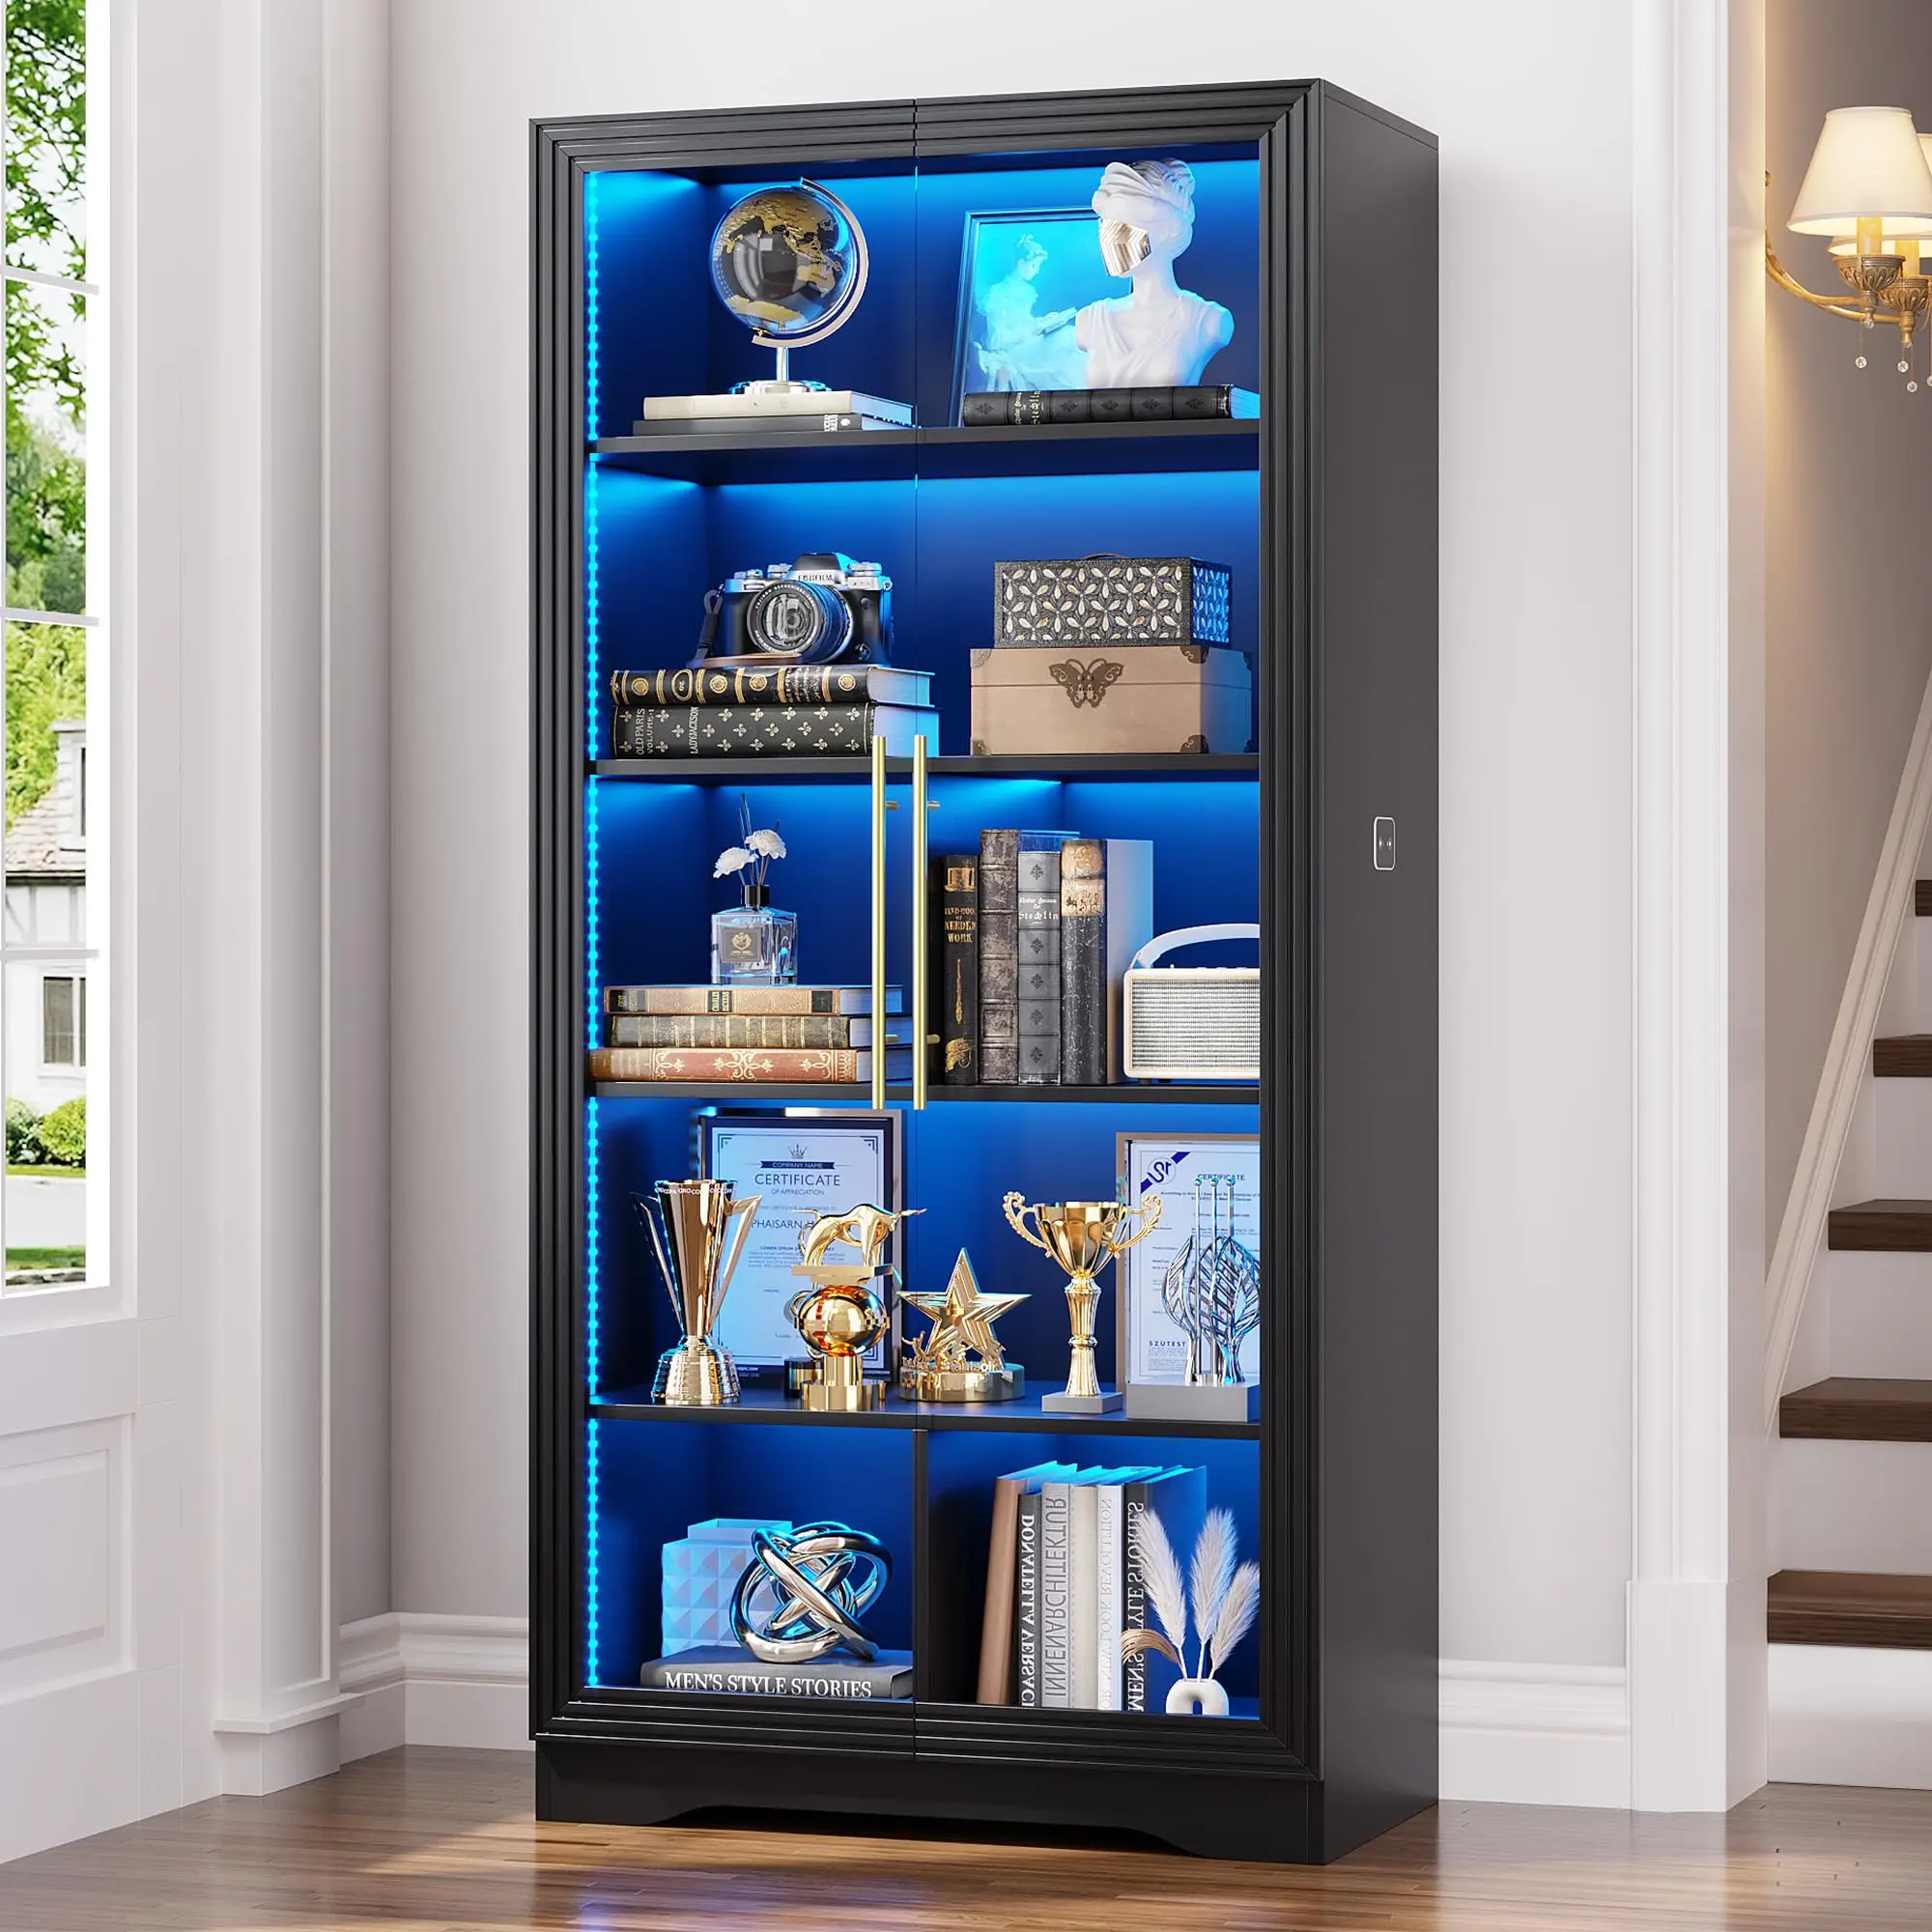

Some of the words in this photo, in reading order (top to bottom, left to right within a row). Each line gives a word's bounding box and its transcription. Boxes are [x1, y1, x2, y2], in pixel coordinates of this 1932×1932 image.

[948, 933, 972, 943] WORK
[754, 1174, 841, 1186] CERTIFICATE
[752, 1219, 803, 1229] PHAISARN
[665, 1671, 723, 1690] MEN'S
[727, 1674, 787, 1694] STYLE
[791, 1679, 873, 1698] STORIES
